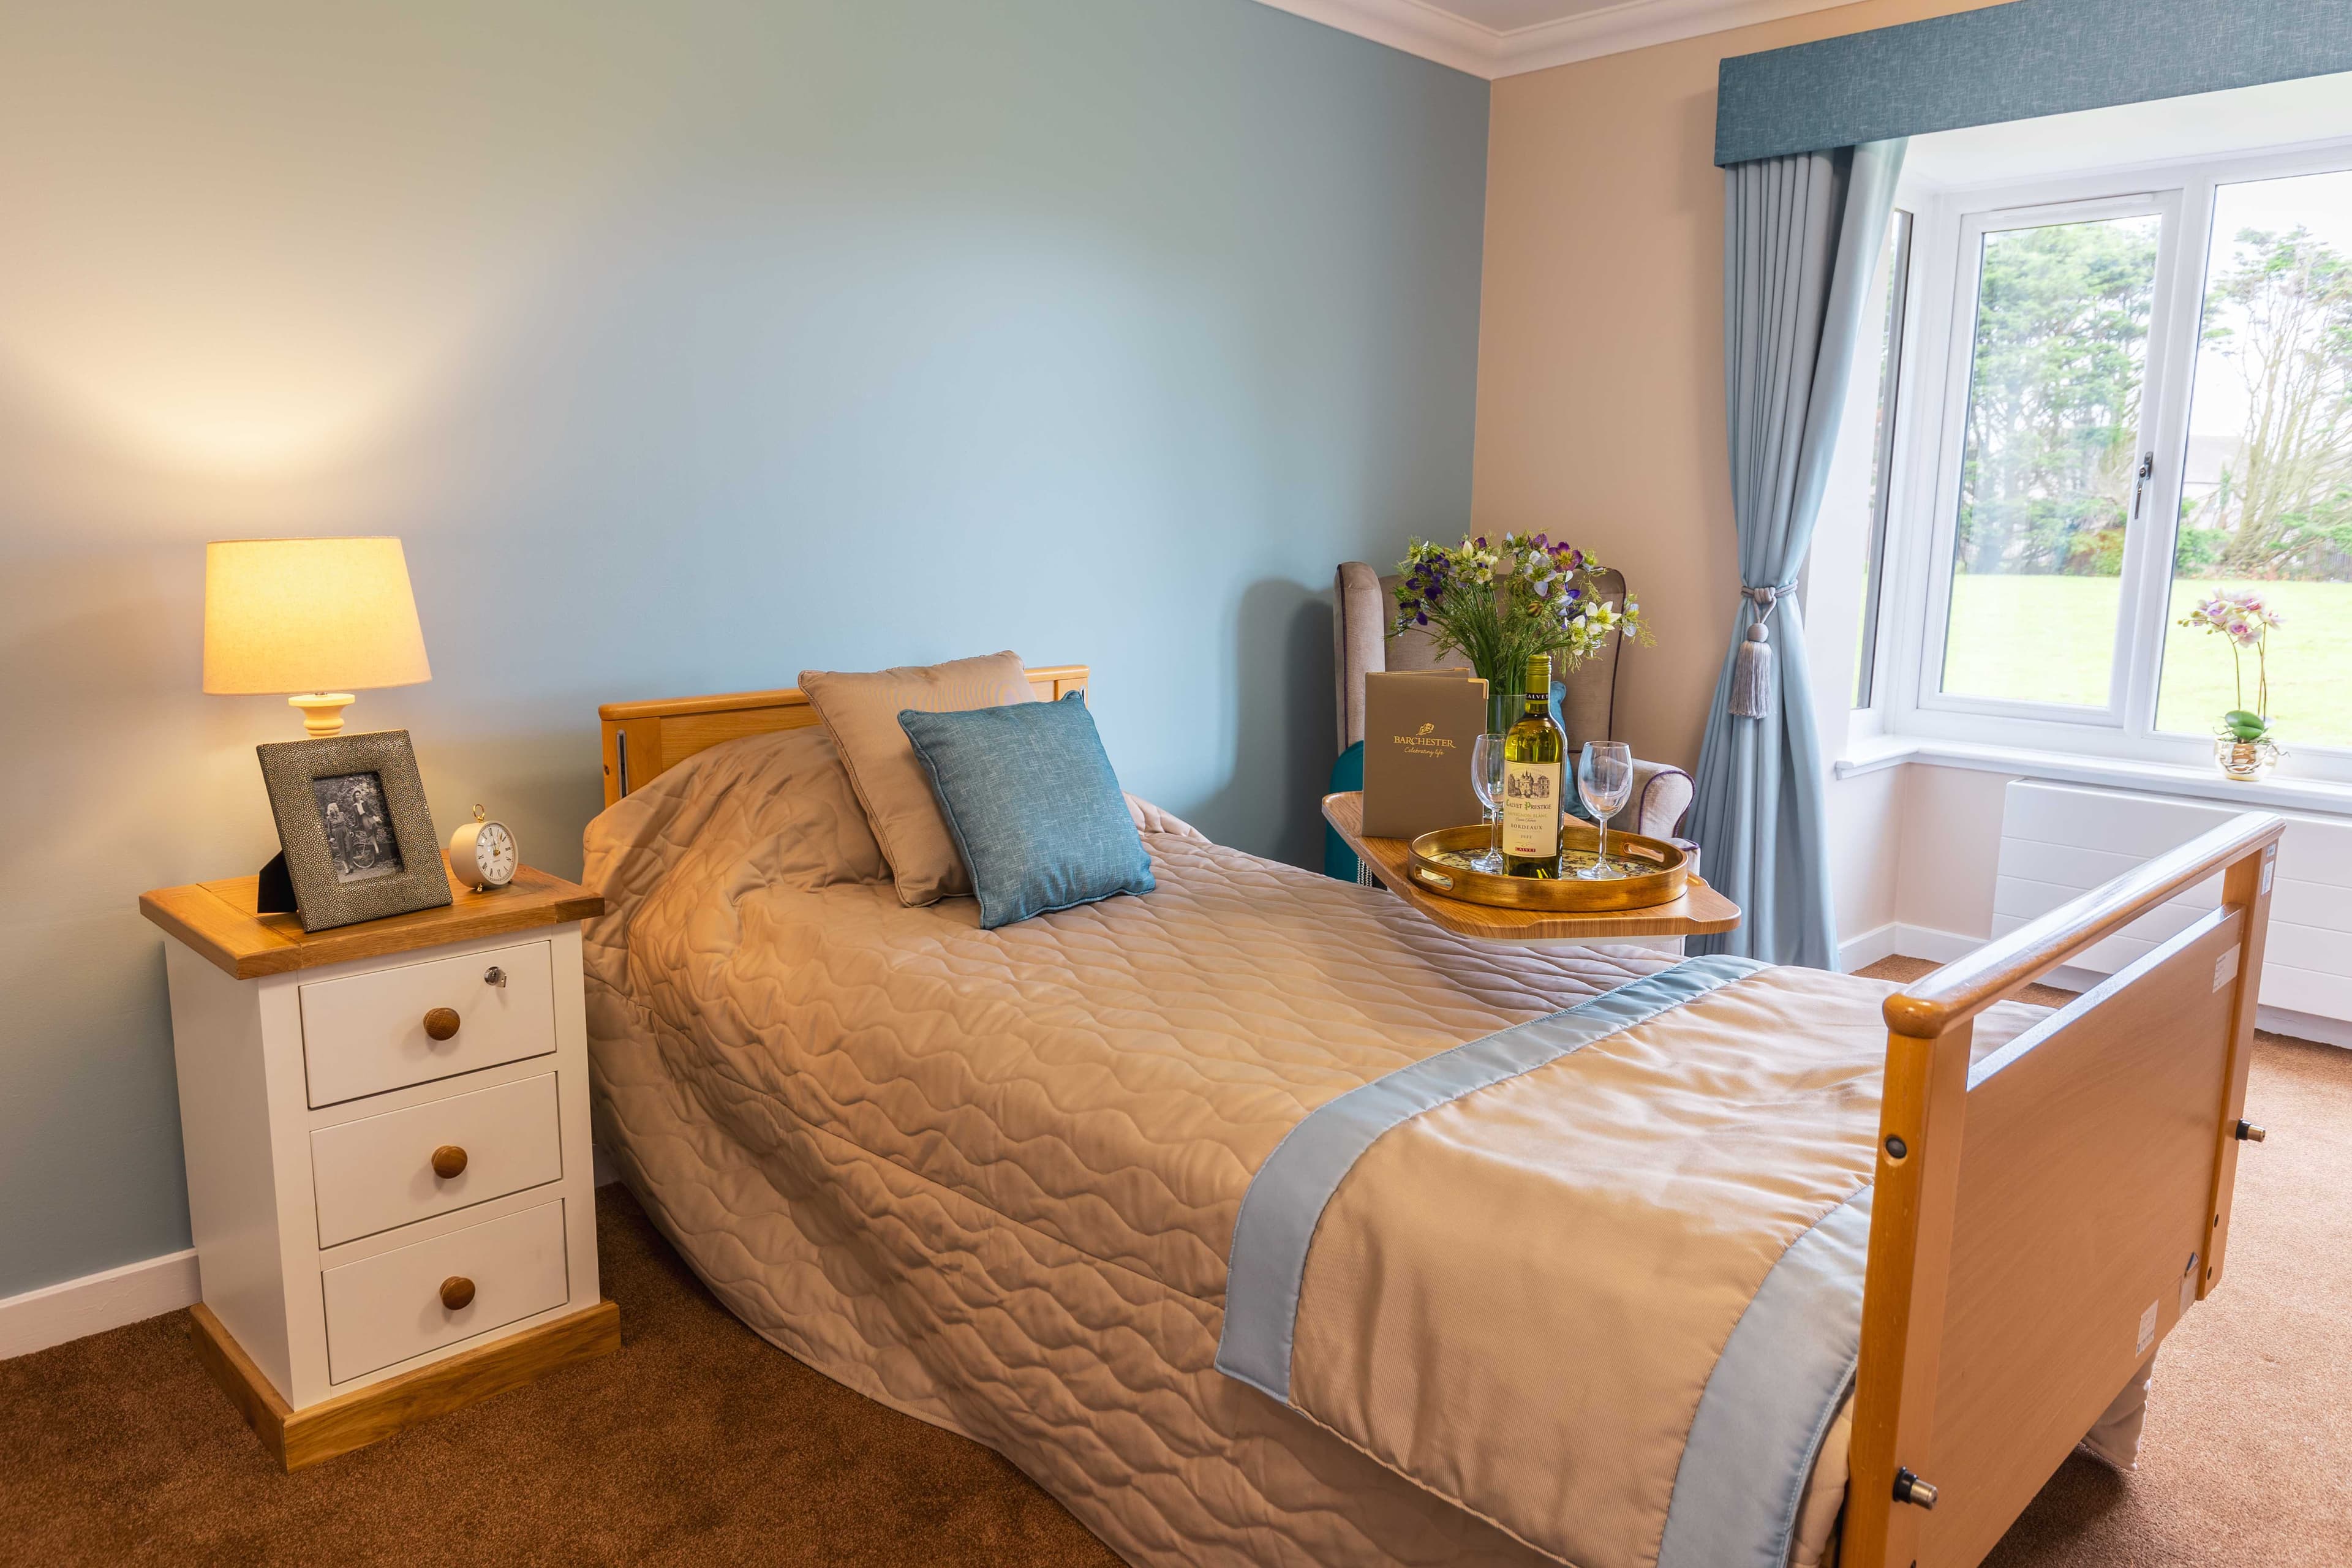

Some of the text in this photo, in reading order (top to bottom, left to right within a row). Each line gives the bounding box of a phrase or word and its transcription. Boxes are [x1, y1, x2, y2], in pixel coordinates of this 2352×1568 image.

[1393, 736, 1456, 748] BARCHESTER
[1404, 747, 1445, 758] Celebrating life
[1525, 802, 1551, 810] PRESTIGE
